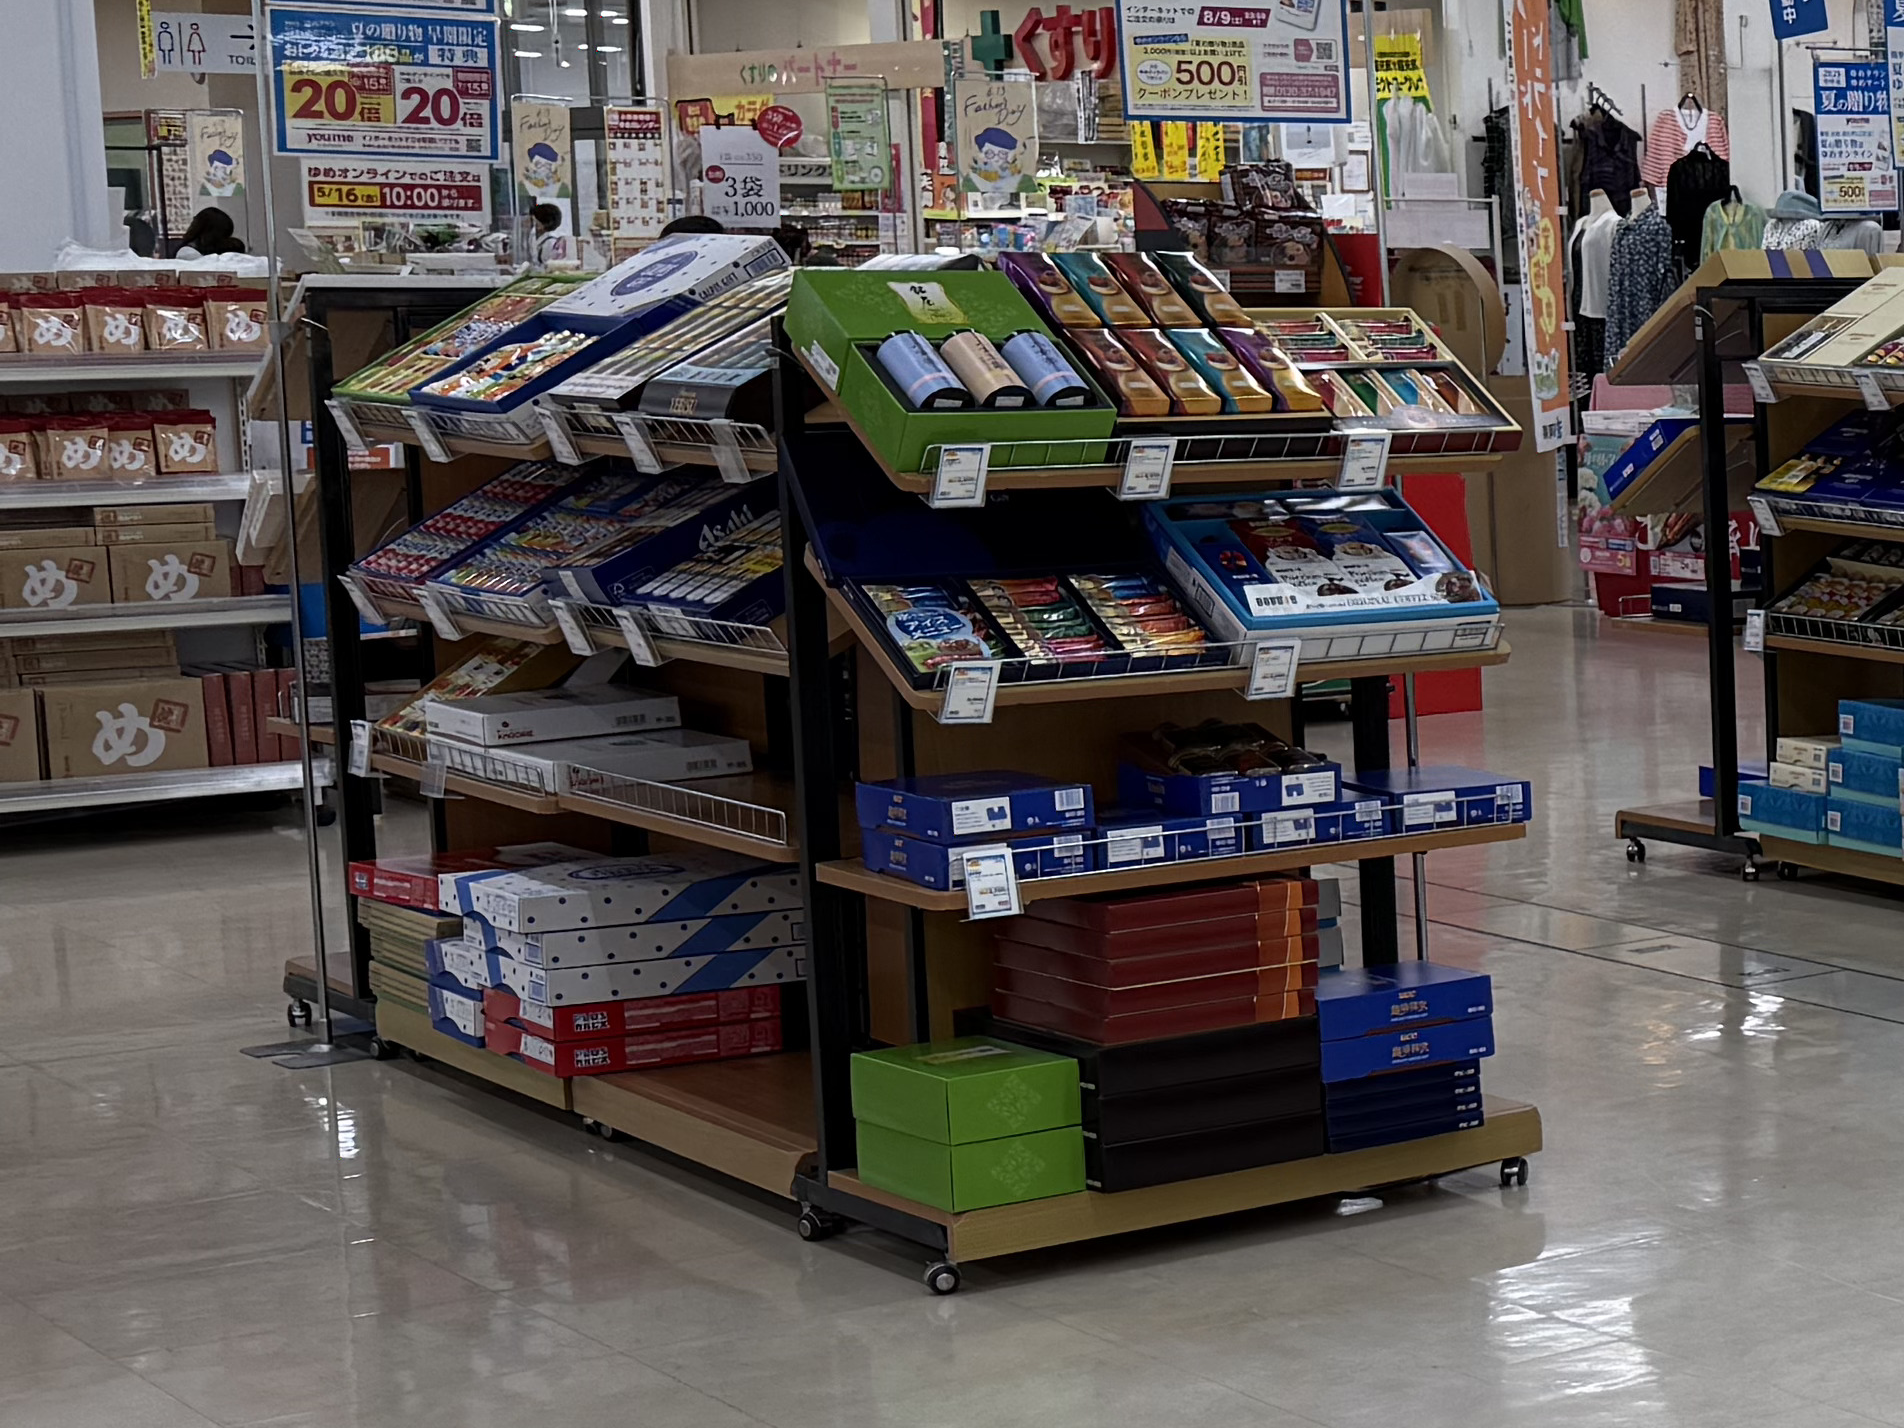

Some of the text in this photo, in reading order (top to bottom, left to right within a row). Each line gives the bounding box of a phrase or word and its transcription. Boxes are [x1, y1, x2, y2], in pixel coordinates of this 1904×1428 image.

[1015, 5, 1116, 80] くすり
[383, 187, 440, 206] 10:00
[699, 504, 754, 552] Asahi
[22, 559, 78, 608] め
[145, 554, 199, 602] め
[93, 702, 166, 767] め
